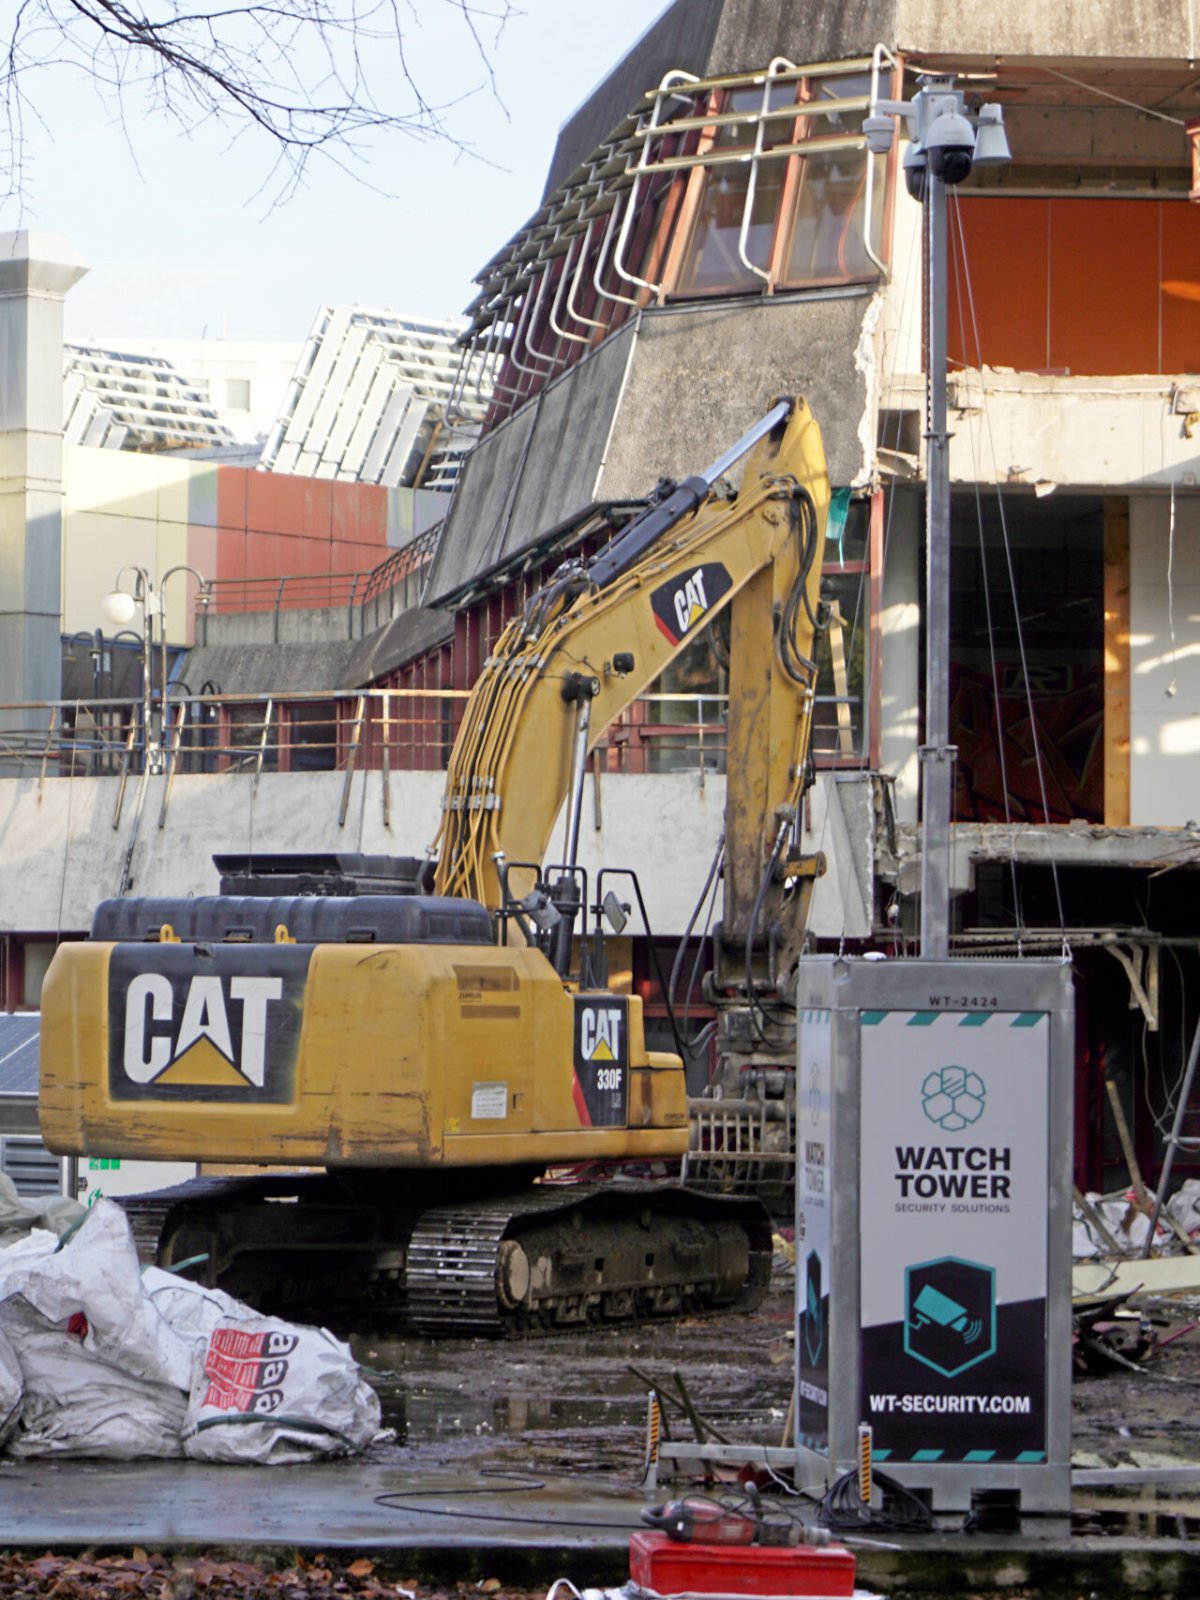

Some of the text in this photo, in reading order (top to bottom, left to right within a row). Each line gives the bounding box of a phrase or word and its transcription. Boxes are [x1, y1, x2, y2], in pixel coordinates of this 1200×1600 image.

[674, 567, 708, 633] CAT
[929, 995, 998, 1007] WT-2424
[123, 972, 283, 1088] CAT
[581, 1007, 622, 1061] CAT
[597, 1068, 623, 1090] 330F
[895, 1146, 1010, 1171] WATCH
[895, 1174, 1010, 1199] TOWER
[895, 1203, 1011, 1214] SECURITY SOLUTIONS
[869, 1394, 1031, 1413] WT-SECURITY.COM
